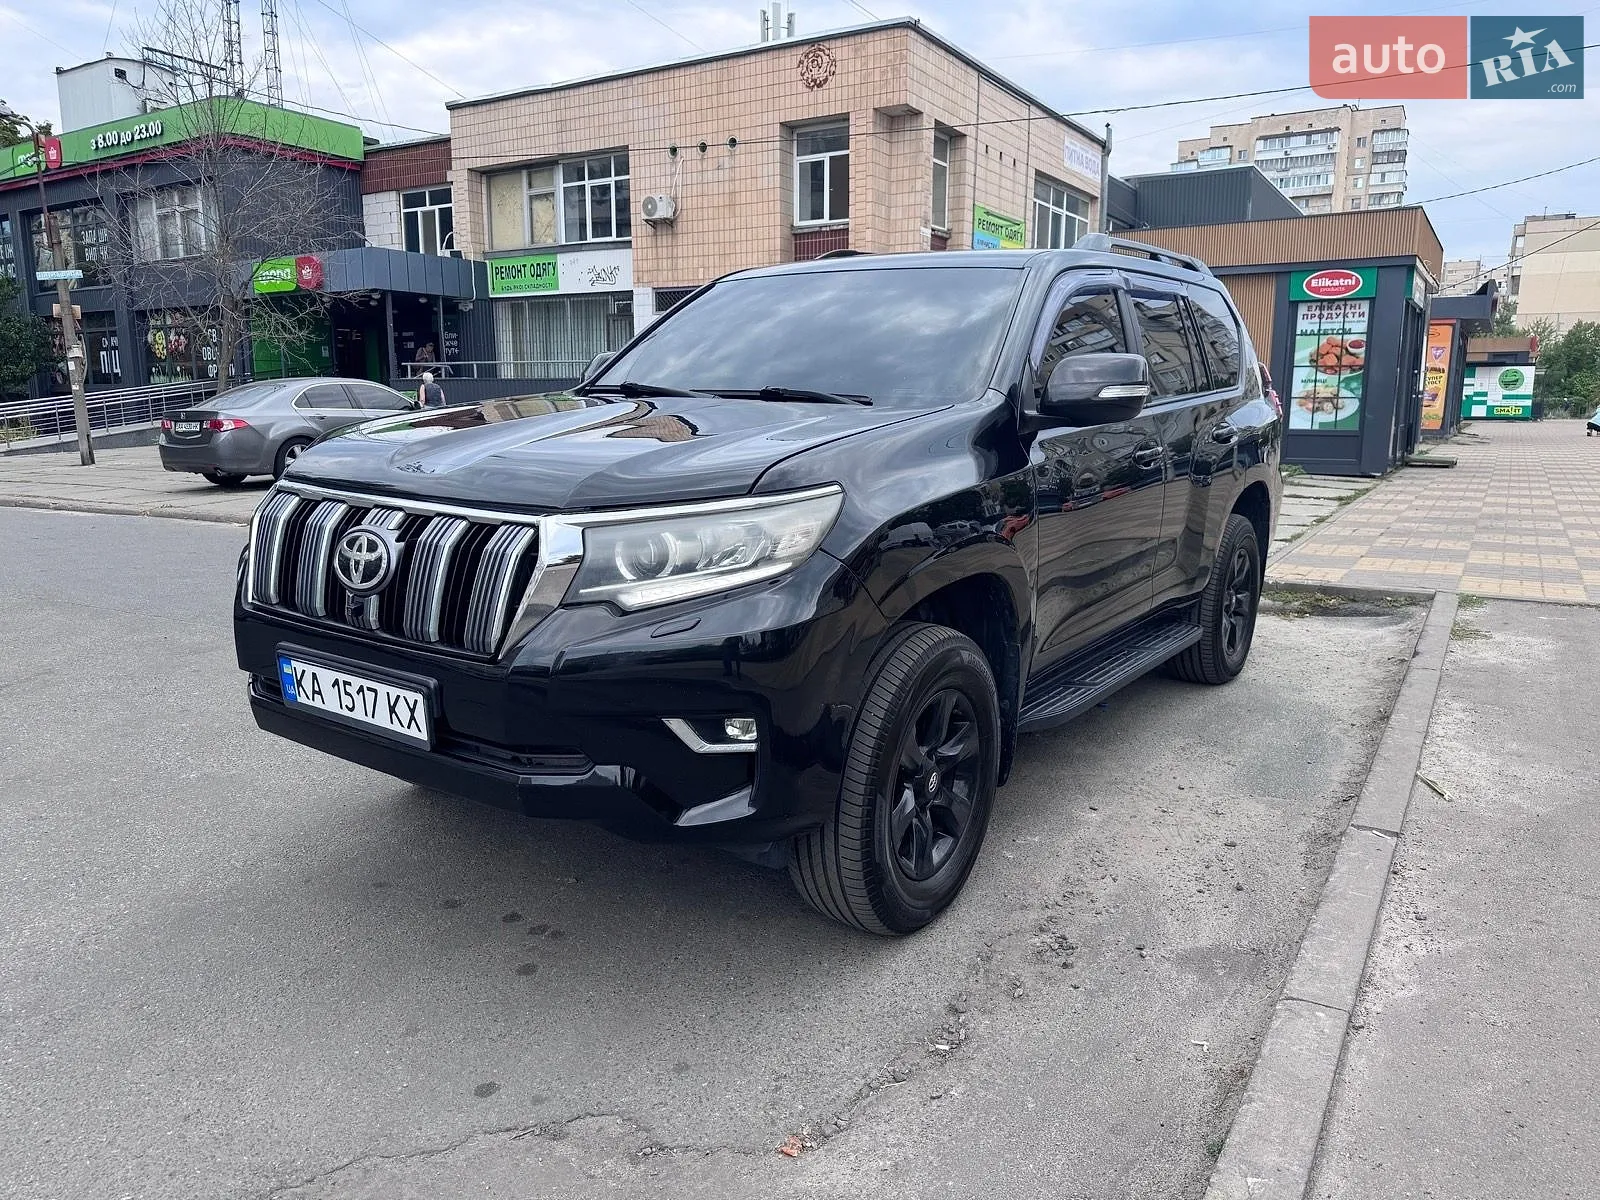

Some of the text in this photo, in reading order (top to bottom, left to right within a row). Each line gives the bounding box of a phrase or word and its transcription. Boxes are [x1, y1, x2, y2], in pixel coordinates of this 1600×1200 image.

[97, 133, 119, 149] 8.00
[120, 132, 132, 146] до
[133, 120, 162, 141] 23.00
[977, 218, 1023, 242] РЕМОНТ ОДЯГУ
[494, 261, 557, 281] РЕМОНТ ОДЯГУ
[1310, 276, 1356, 287] Elikatni
[1307, 303, 1362, 312] ЕЛІКАТНІ
[1302, 311, 1366, 320] ПРОДУКТИ
[285, 684, 296, 695] UA
[294, 667, 422, 733] KA 1517 KX
